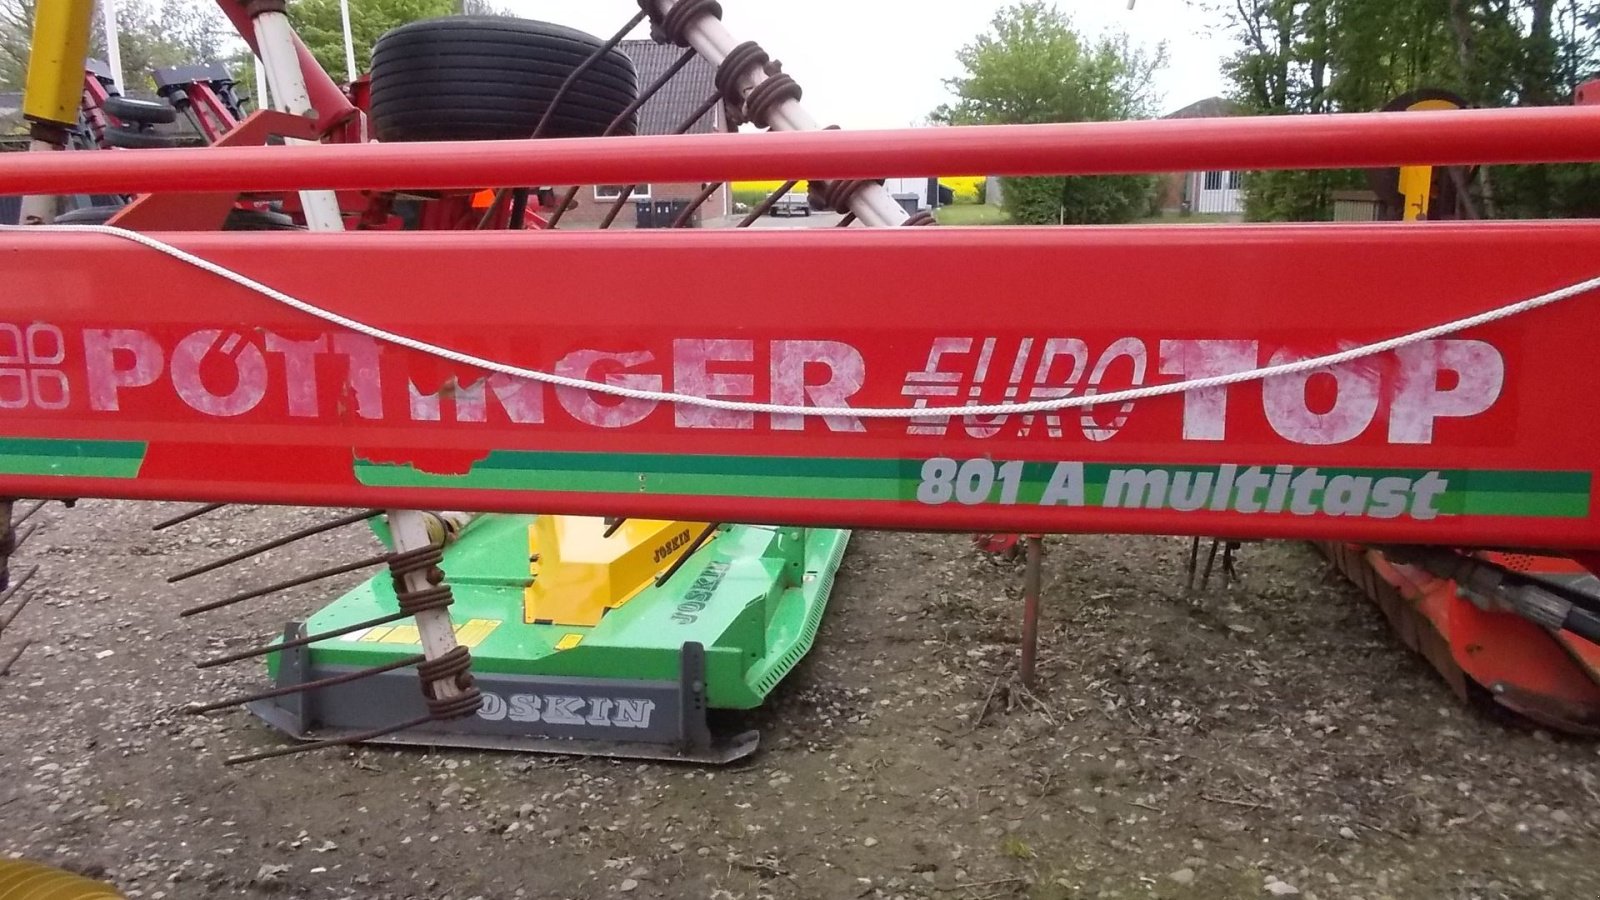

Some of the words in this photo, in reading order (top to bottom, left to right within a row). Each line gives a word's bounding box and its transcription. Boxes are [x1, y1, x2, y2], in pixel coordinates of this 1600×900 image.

[901, 337, 1147, 441] EURO
[1159, 339, 1505, 445] TOP
[916, 457, 1024, 506] 801
[1039, 461, 1085, 507] A
[1102, 463, 1448, 519] multitast
[653, 528, 691, 563] JOSKIN
[671, 560, 731, 625] JOSKIN
[476, 691, 655, 729] OSKIN
